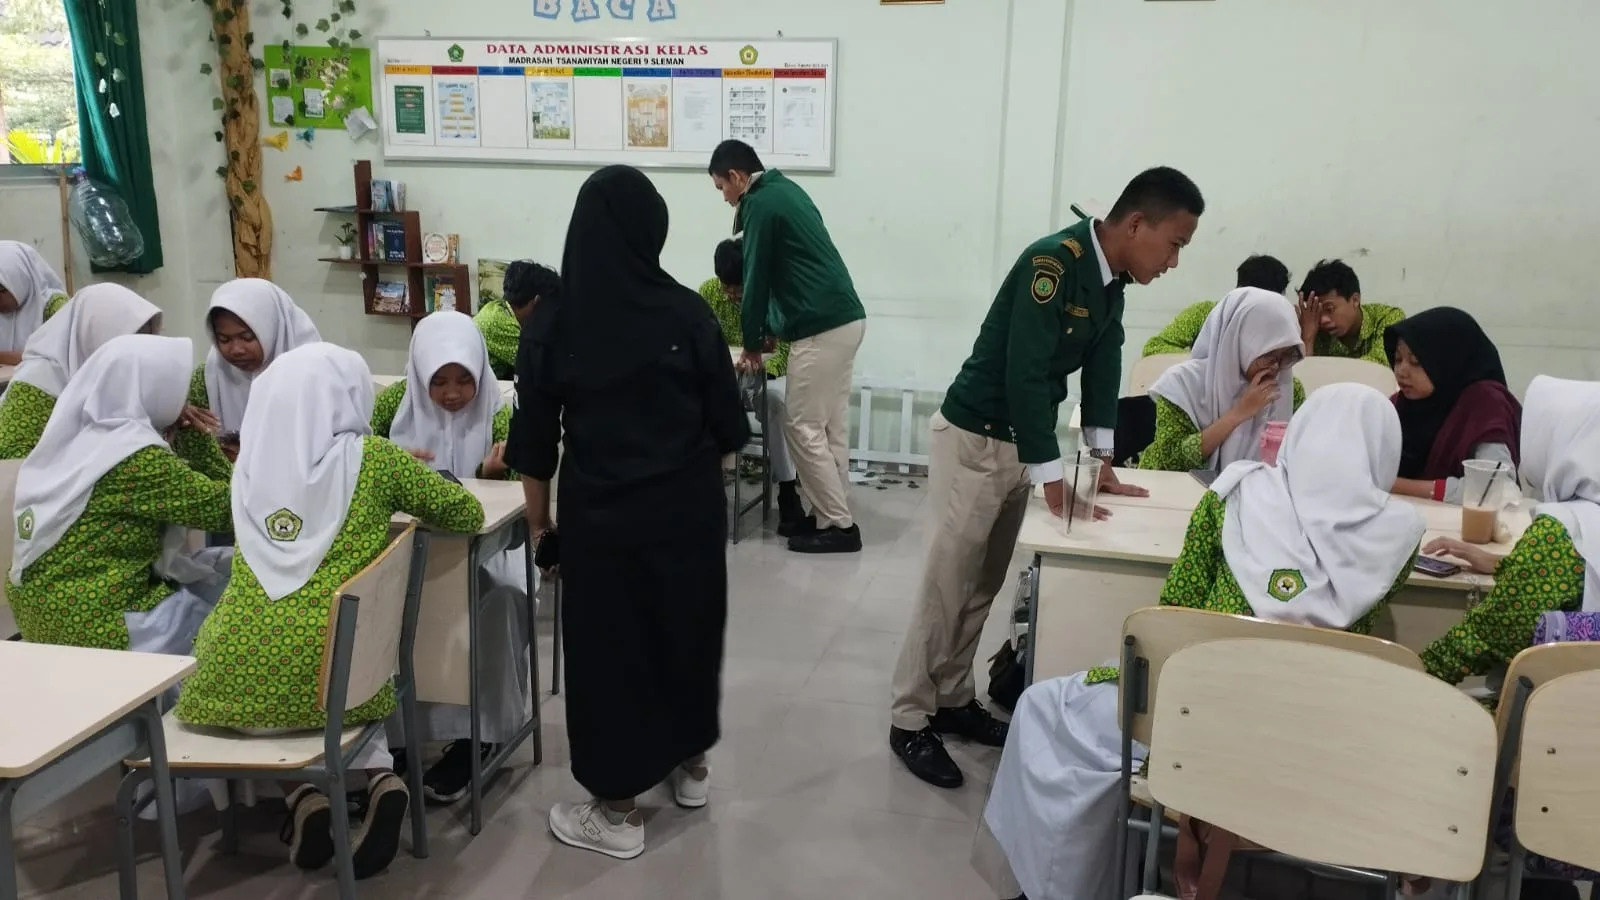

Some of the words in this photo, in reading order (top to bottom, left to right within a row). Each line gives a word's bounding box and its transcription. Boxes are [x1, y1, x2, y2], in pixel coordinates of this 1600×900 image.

[487, 44, 526, 54] DATA
[533, 44, 649, 56] ADMINISTRASI
[657, 45, 708, 56] KELAS
[509, 56, 553, 64] MADRASAH
[556, 57, 608, 65] TSANAWIYAH
[611, 57, 642, 65] NEGERI
[643, 57, 649, 65] 9
[651, 58, 684, 66] SLEMAN
